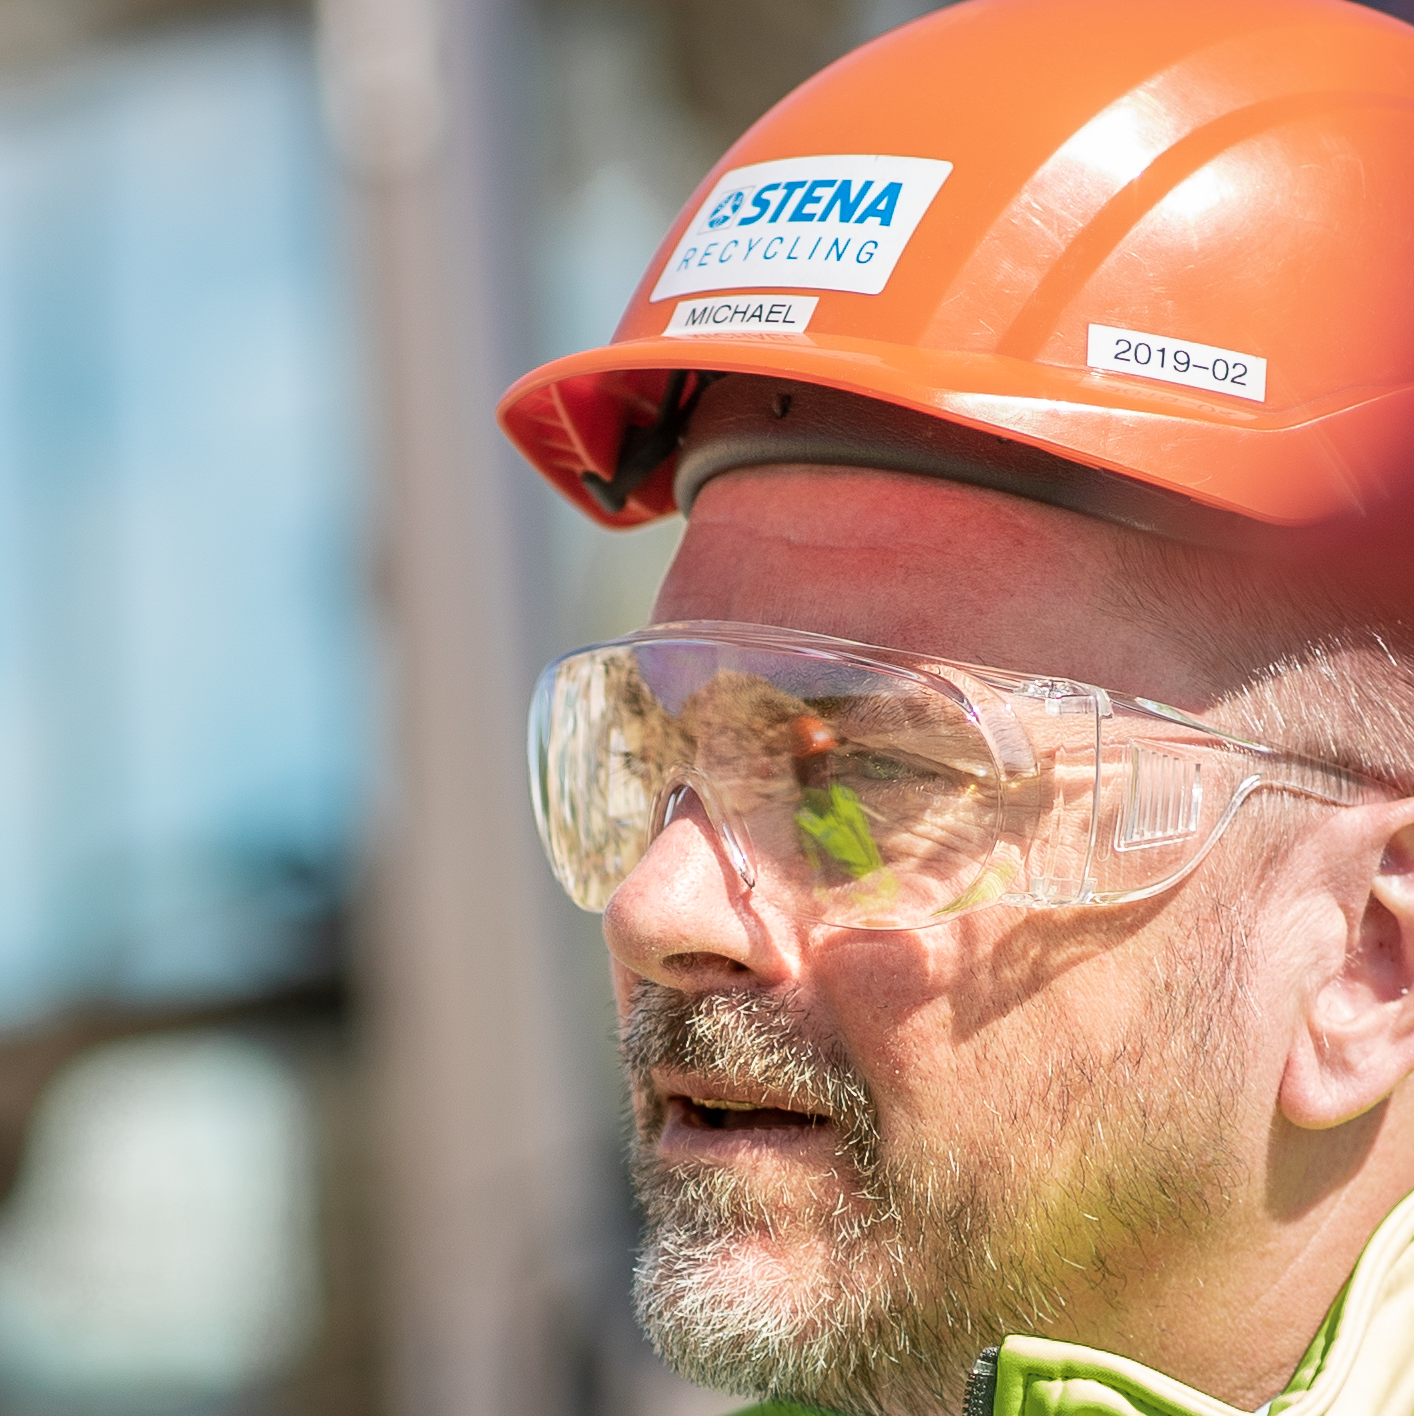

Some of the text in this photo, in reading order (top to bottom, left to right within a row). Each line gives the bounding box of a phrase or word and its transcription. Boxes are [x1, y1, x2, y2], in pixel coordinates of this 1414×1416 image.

[737, 179, 903, 227] STENA
[676, 236, 879, 272] RECYCLING
[685, 304, 796, 326] MICHAEL
[1114, 339, 1248, 386] 2019-02
